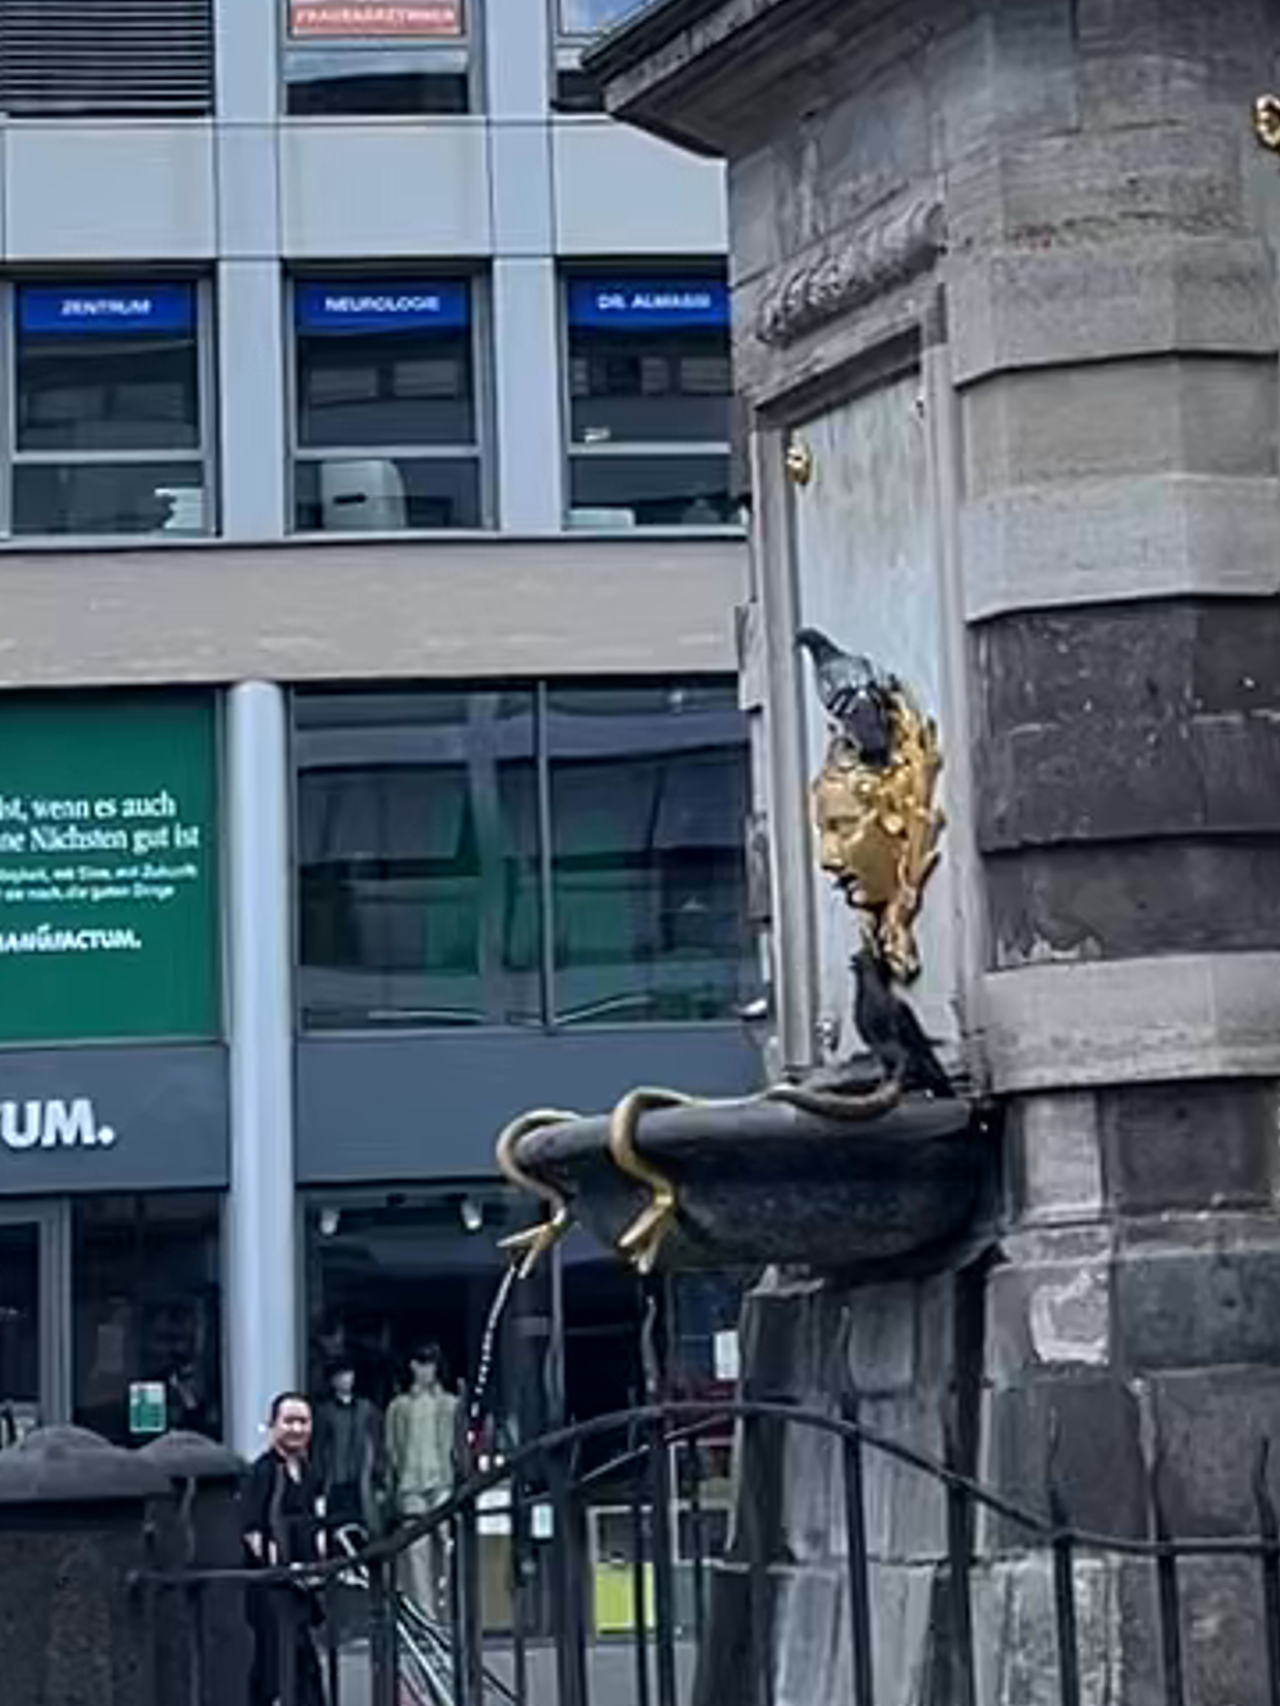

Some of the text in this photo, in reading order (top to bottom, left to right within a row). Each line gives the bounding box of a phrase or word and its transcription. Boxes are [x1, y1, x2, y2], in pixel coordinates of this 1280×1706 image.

[324, 295, 441, 313] NEUROLOGIE
[31, 798, 88, 819] wenn
[93, 797, 117, 818] es
[121, 789, 177, 818] auch
[29, 825, 127, 852] Nächsten
[132, 827, 169, 856] gut
[174, 822, 199, 848] ist
